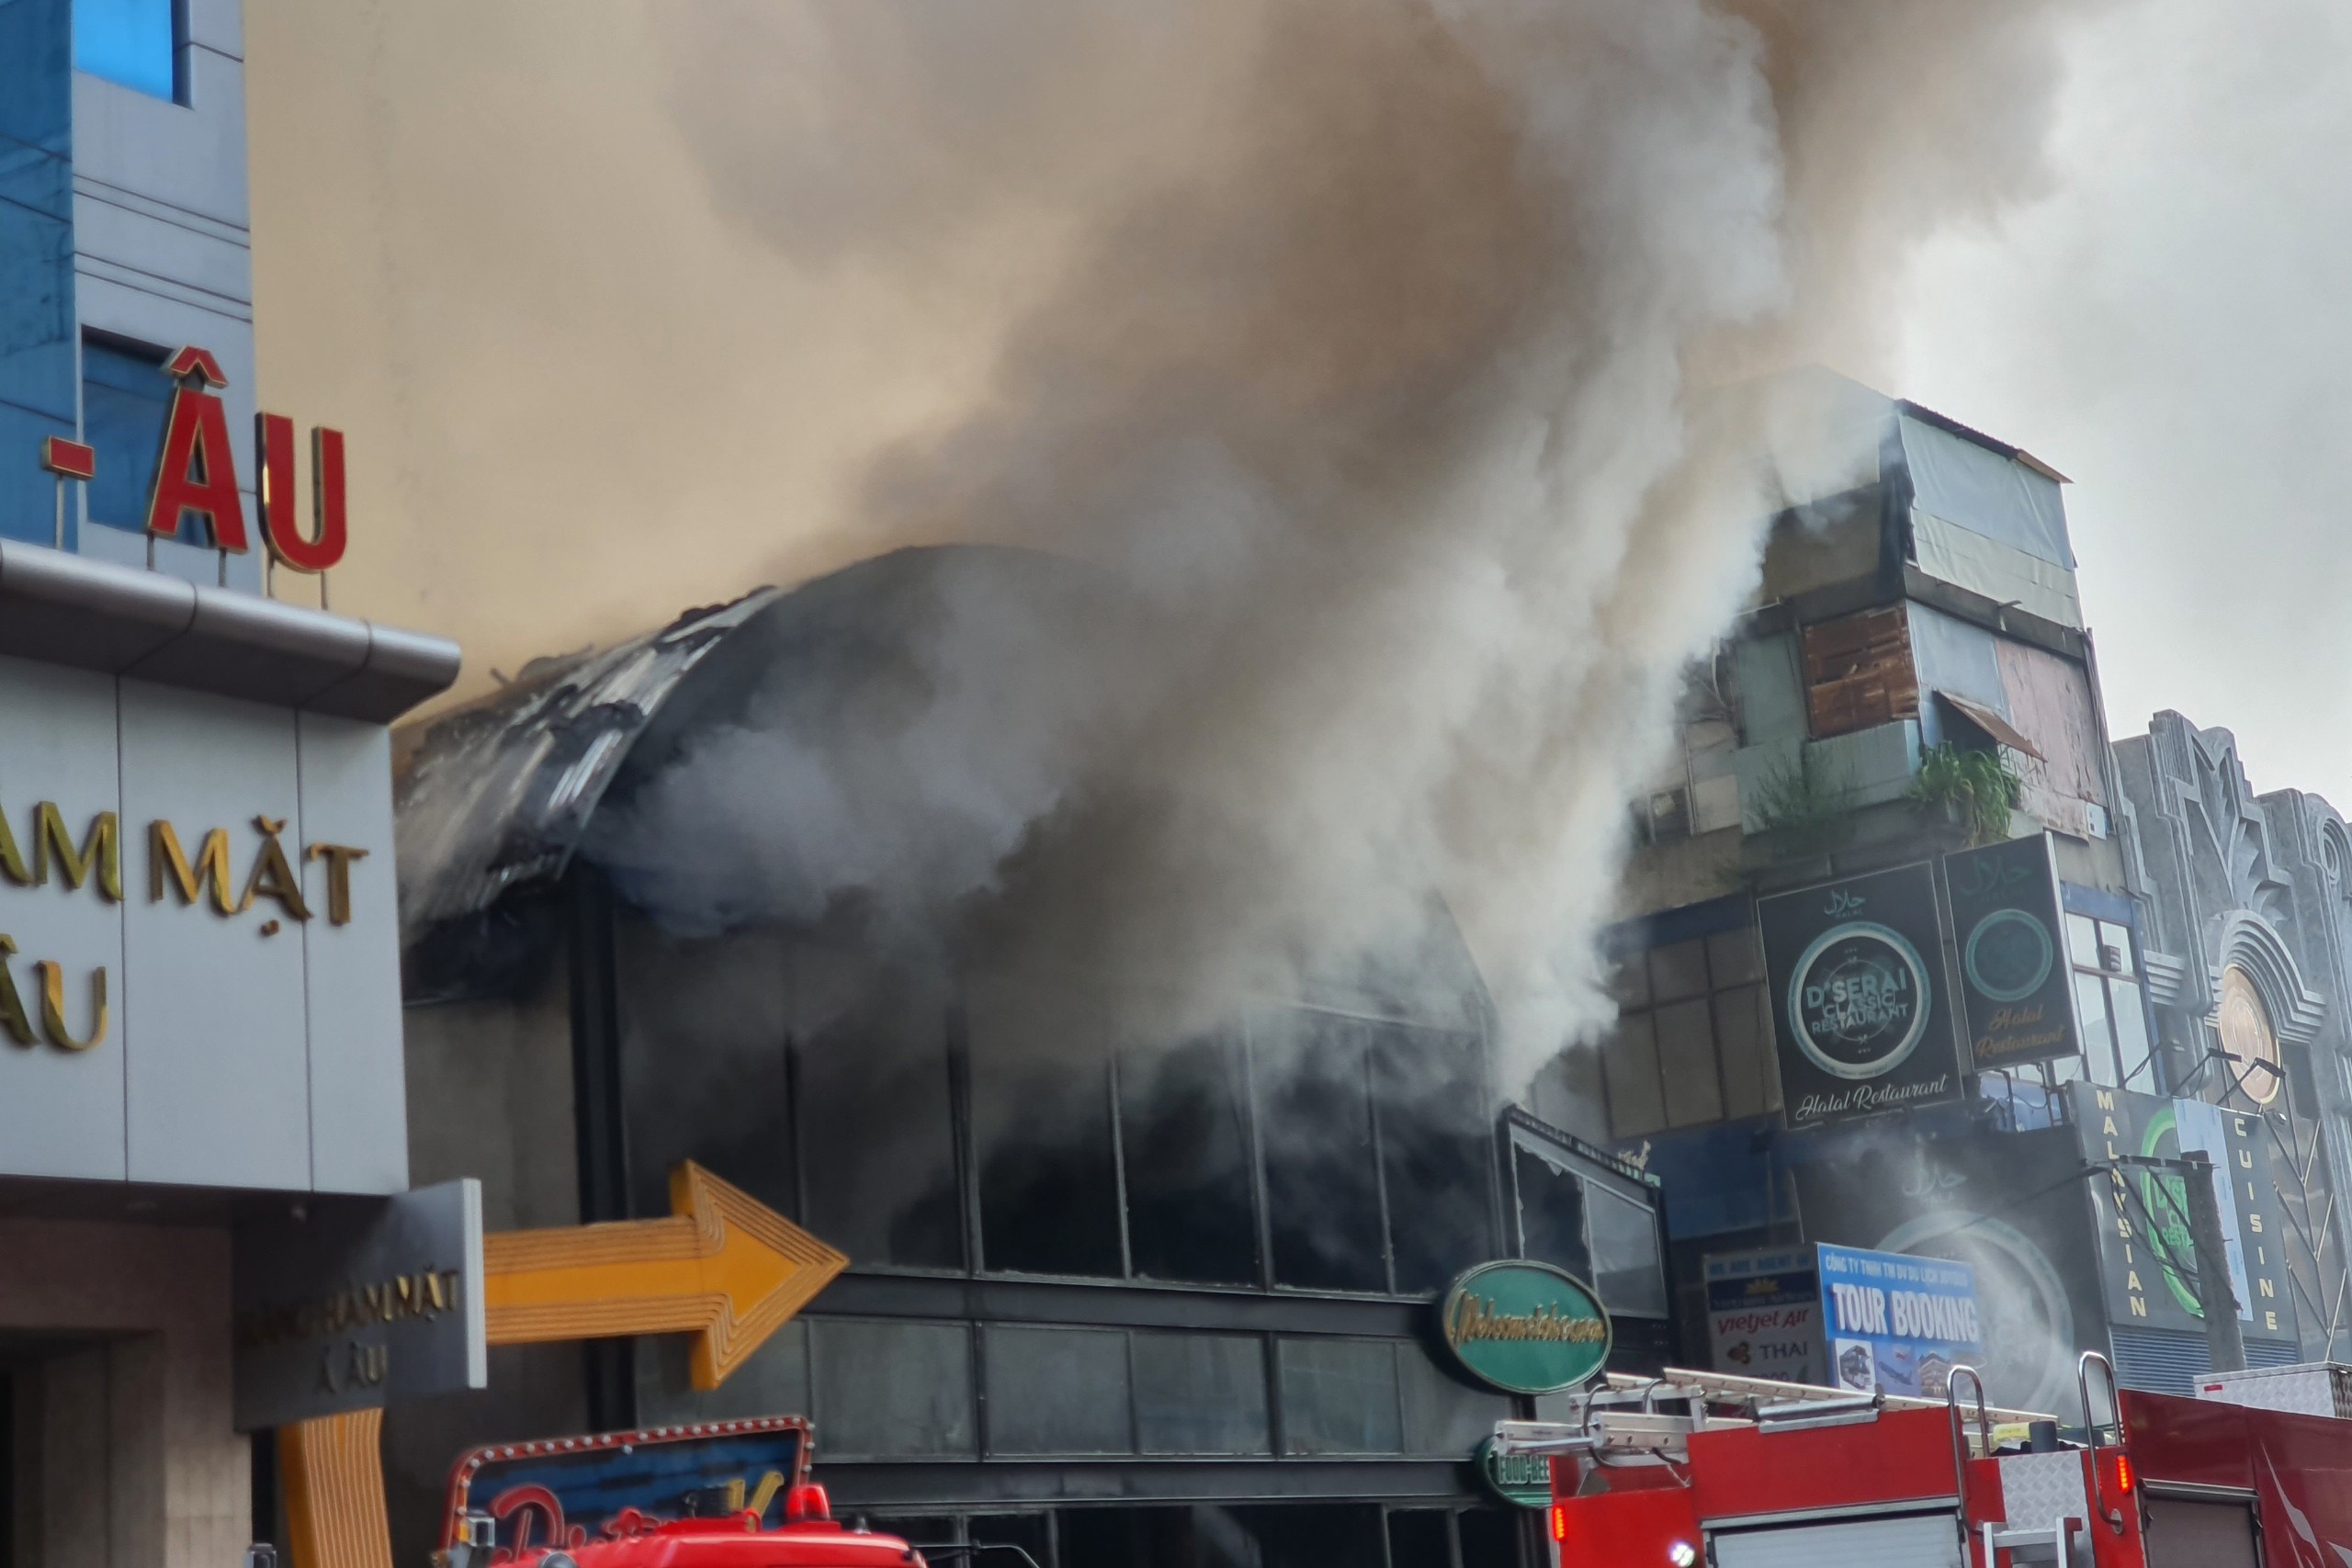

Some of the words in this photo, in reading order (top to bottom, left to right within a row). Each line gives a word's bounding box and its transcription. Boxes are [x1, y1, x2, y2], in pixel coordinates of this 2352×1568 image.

[144, 345, 347, 574] ÂU
[148, 814, 369, 937] MẶT
[1806, 967, 1907, 1009] D'SERAI
[1812, 1004, 1909, 1034] RESTAURANT
[1795, 1090, 1851, 1121] Halal
[1852, 1073, 1949, 1110] Restaurant
[2234, 1118, 2278, 1331] CUISINE
[1783, 1308, 1809, 1329] Air
[1831, 1282, 1888, 1336] TOUR
[1890, 1290, 1980, 1343] BOOKING
[1759, 1340, 1808, 1359] THAI
